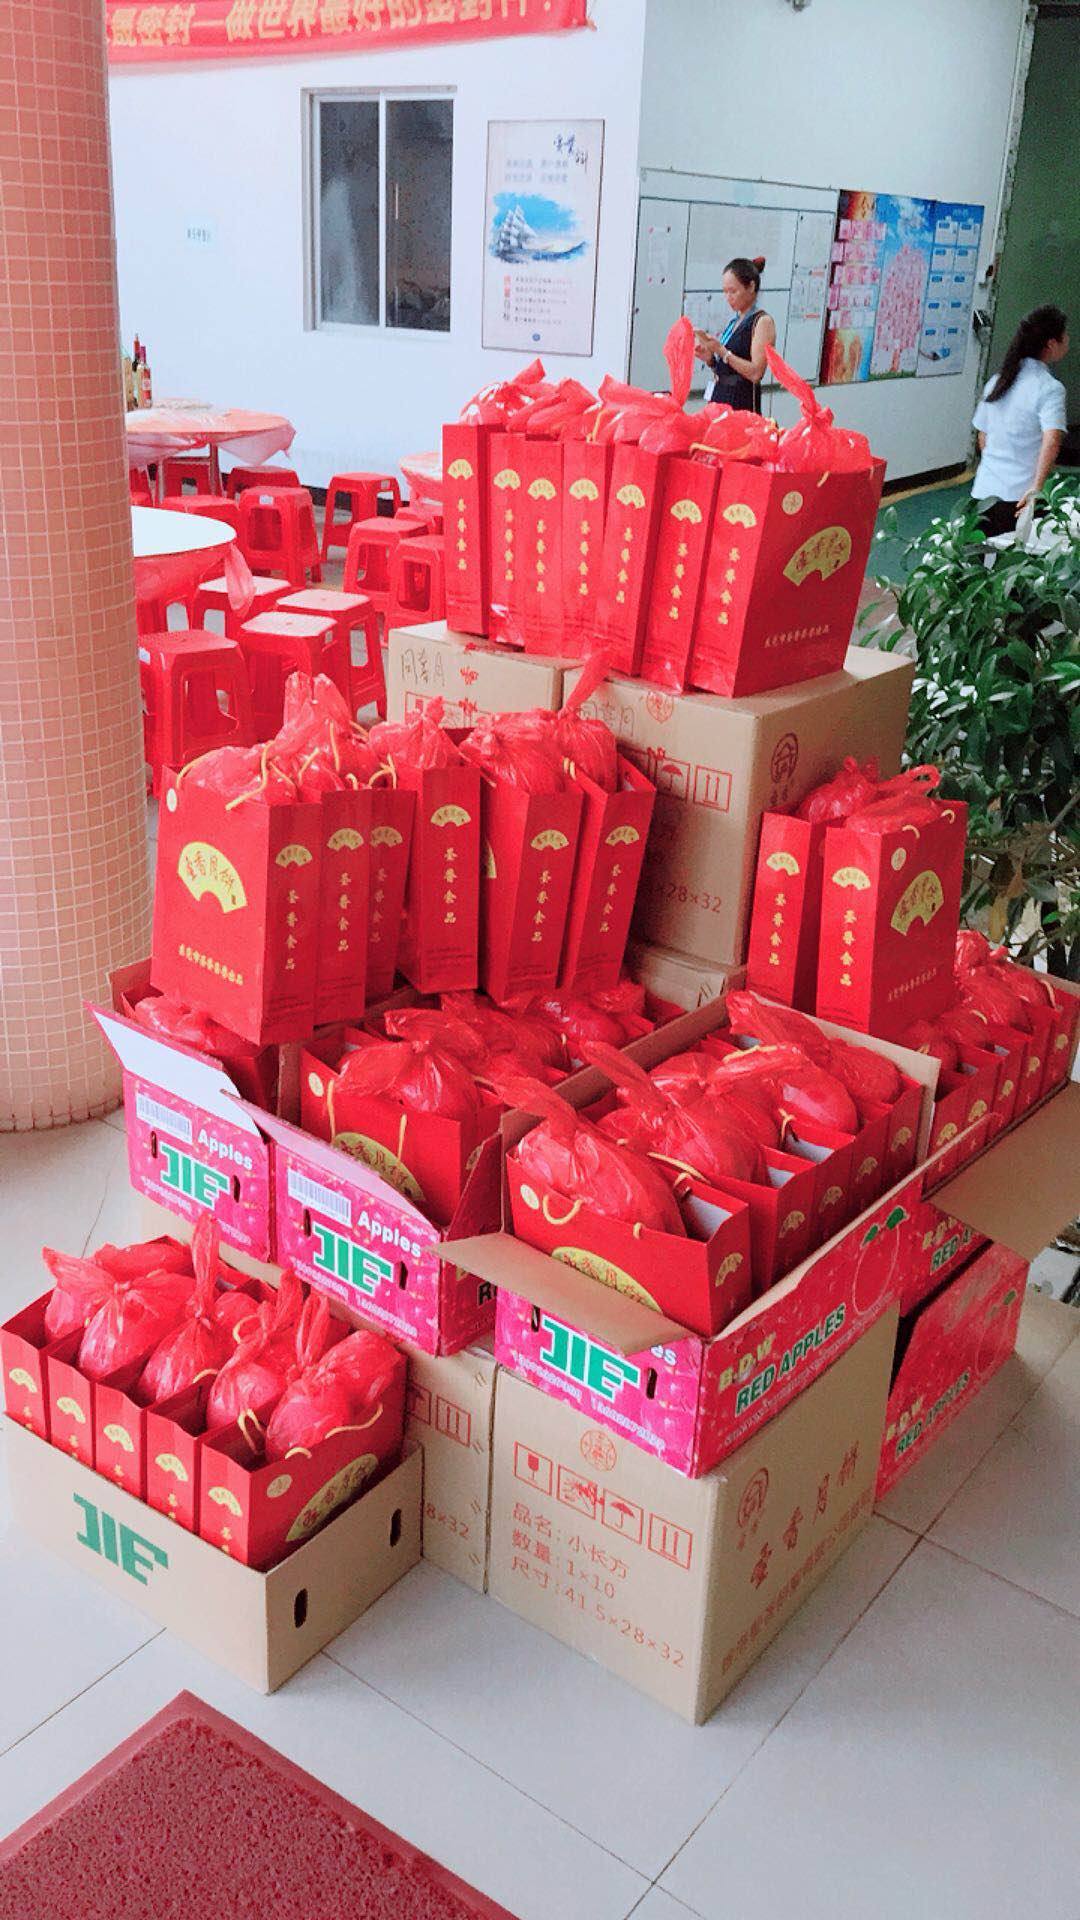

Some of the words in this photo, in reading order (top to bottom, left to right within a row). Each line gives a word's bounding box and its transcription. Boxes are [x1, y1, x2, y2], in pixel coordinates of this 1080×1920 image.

[198, 1128, 252, 1171] Apples
[358, 1210, 421, 1258] Apples
[735, 1363, 776, 1418] RED
[777, 1302, 847, 1380] APPLES
